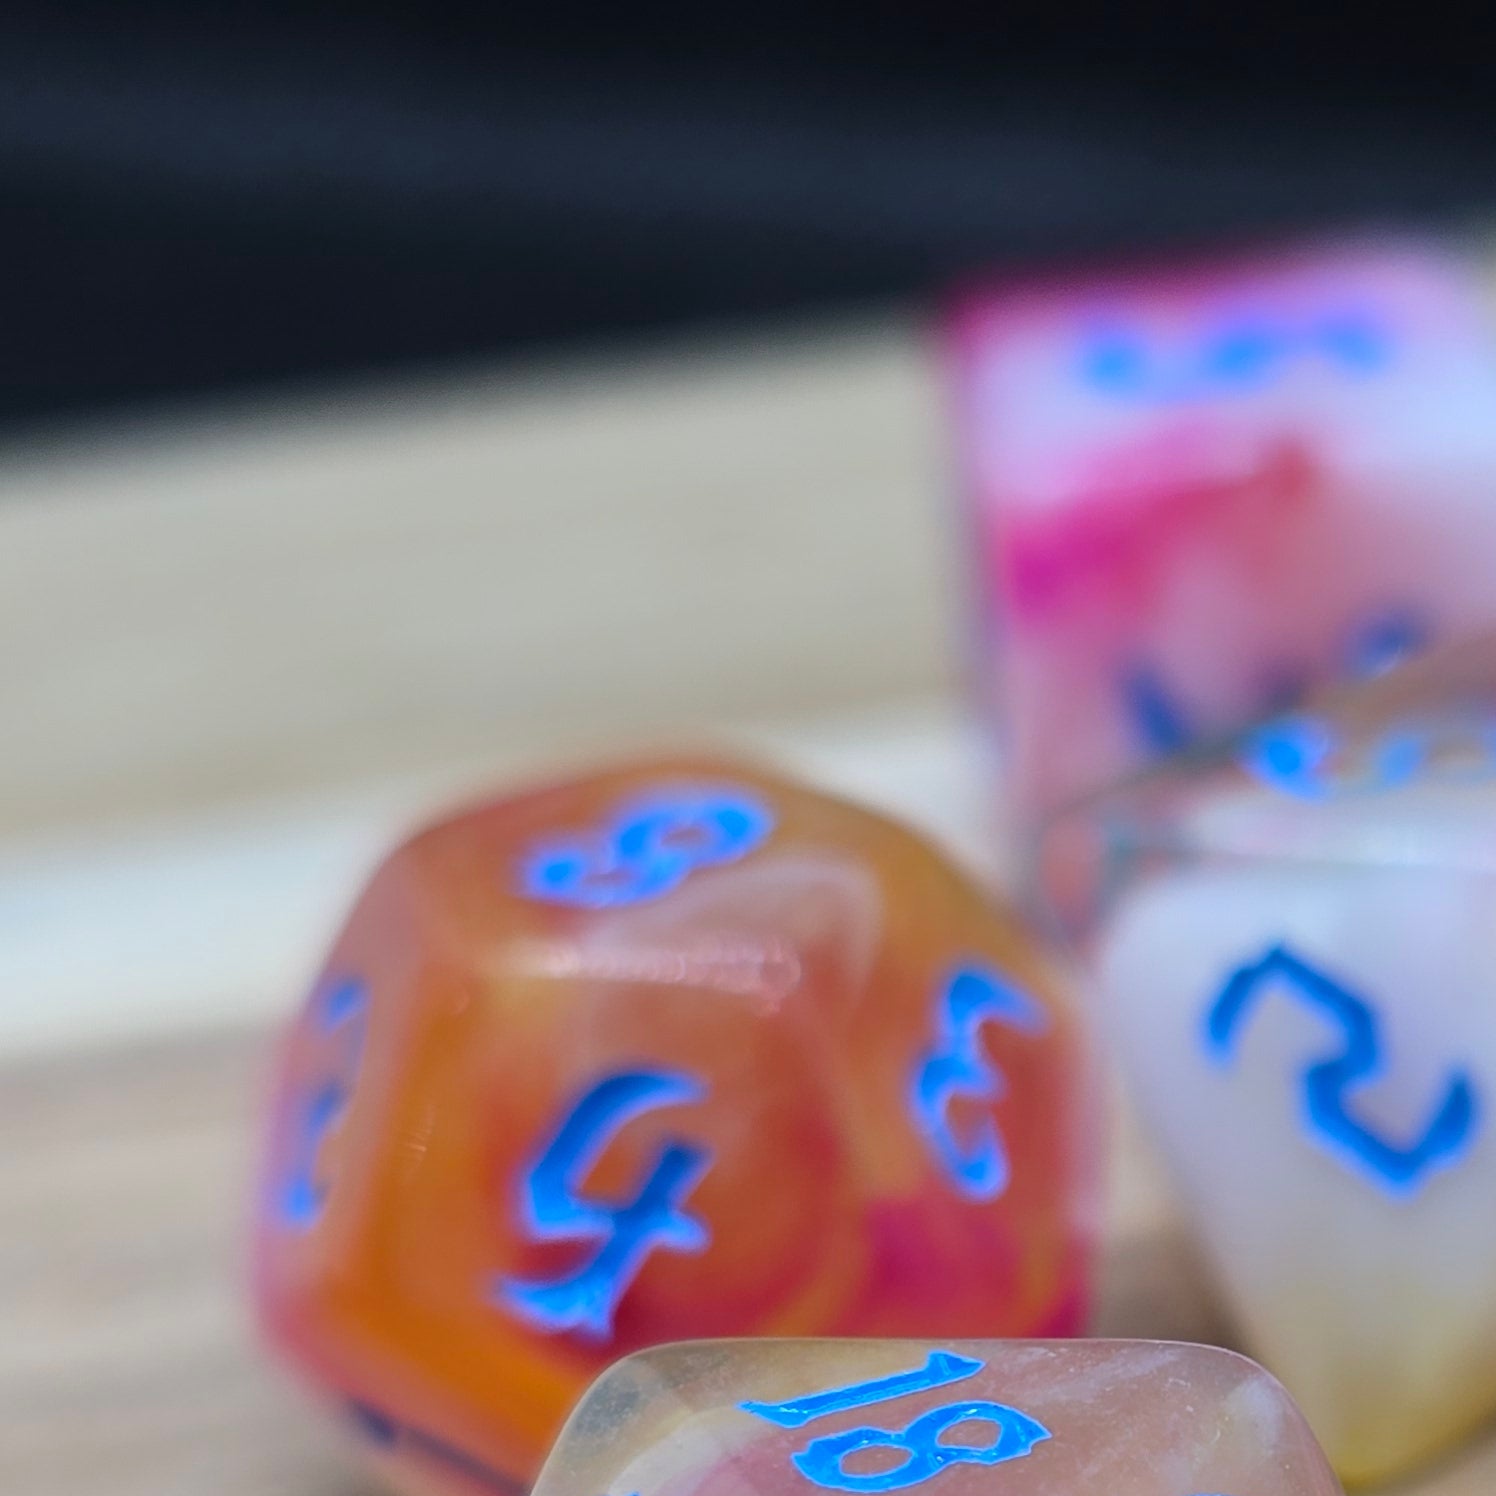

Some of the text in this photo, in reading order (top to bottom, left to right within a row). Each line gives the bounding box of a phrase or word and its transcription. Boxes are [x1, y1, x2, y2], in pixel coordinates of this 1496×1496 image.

[1192, 934, 1490, 1202] 2
[500, 1070, 706, 1335] 4
[735, 1349, 1052, 1494] 18
